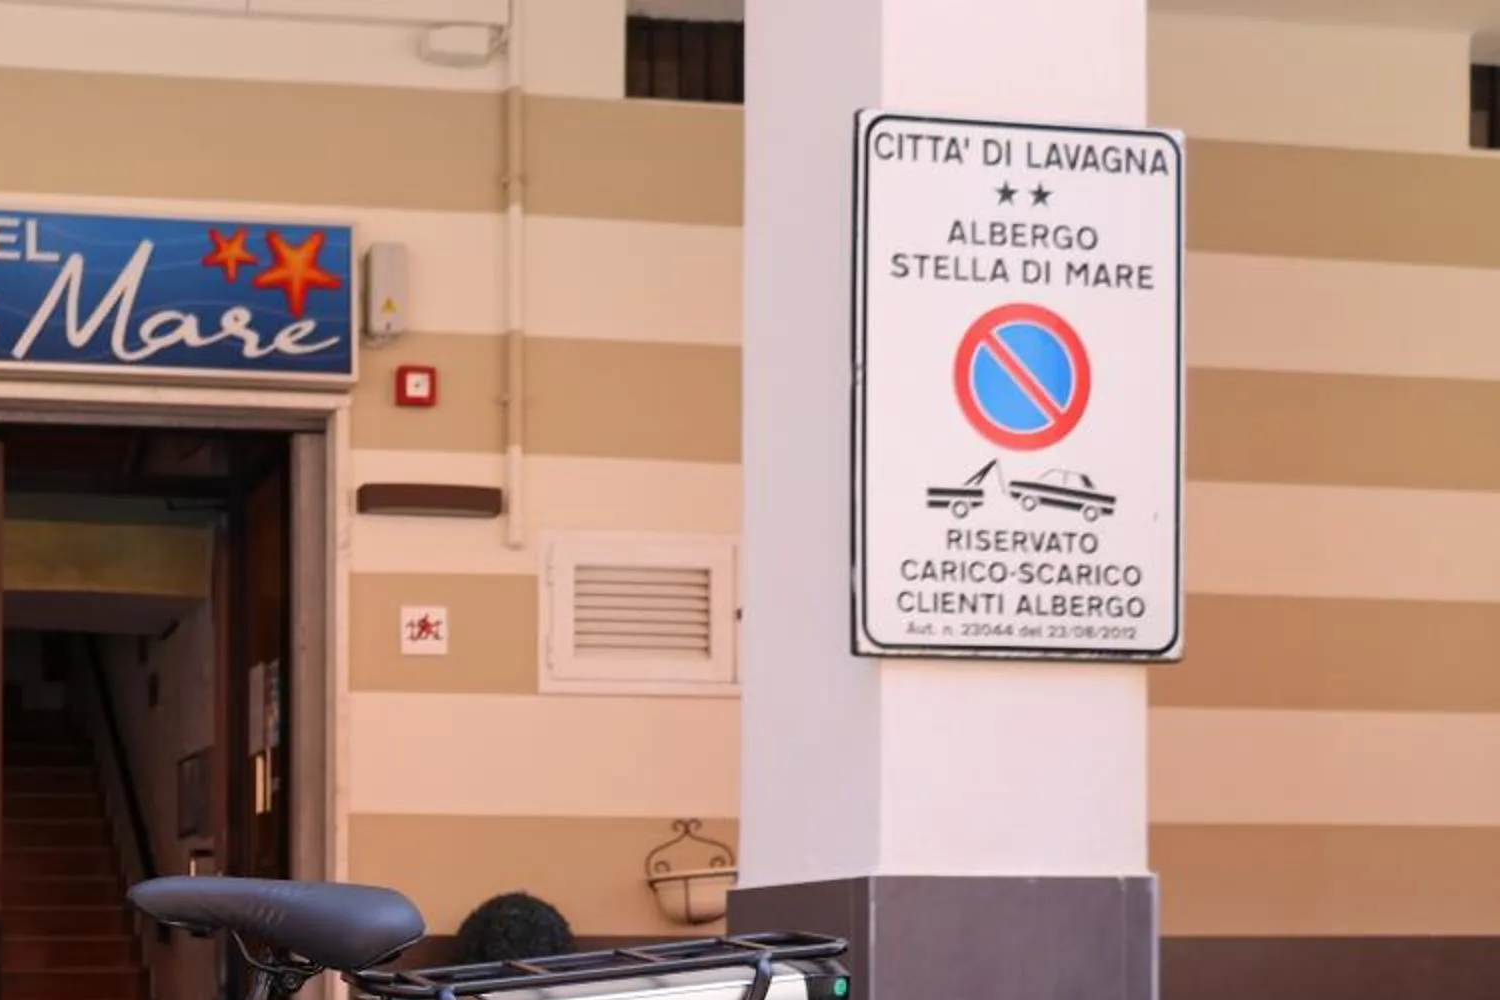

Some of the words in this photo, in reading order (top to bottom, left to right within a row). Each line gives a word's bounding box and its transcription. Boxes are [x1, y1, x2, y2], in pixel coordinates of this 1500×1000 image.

[874, 131, 970, 164] CITTA'
[983, 139, 1011, 166] DI
[1027, 142, 1169, 175] LAVAGNA
[948, 220, 1098, 250] ALBERGO
[891, 254, 1010, 283] STELLA
[1022, 260, 1051, 284] DI
[1066, 263, 1154, 289] MARE
[11, 240, 341, 360] Mare
[946, 529, 1098, 554] RISERVATO
[900, 560, 1142, 587] CARICO-SCARICO
[897, 592, 1004, 616] CLIENTI
[1016, 596, 1145, 619] ALBERGO
